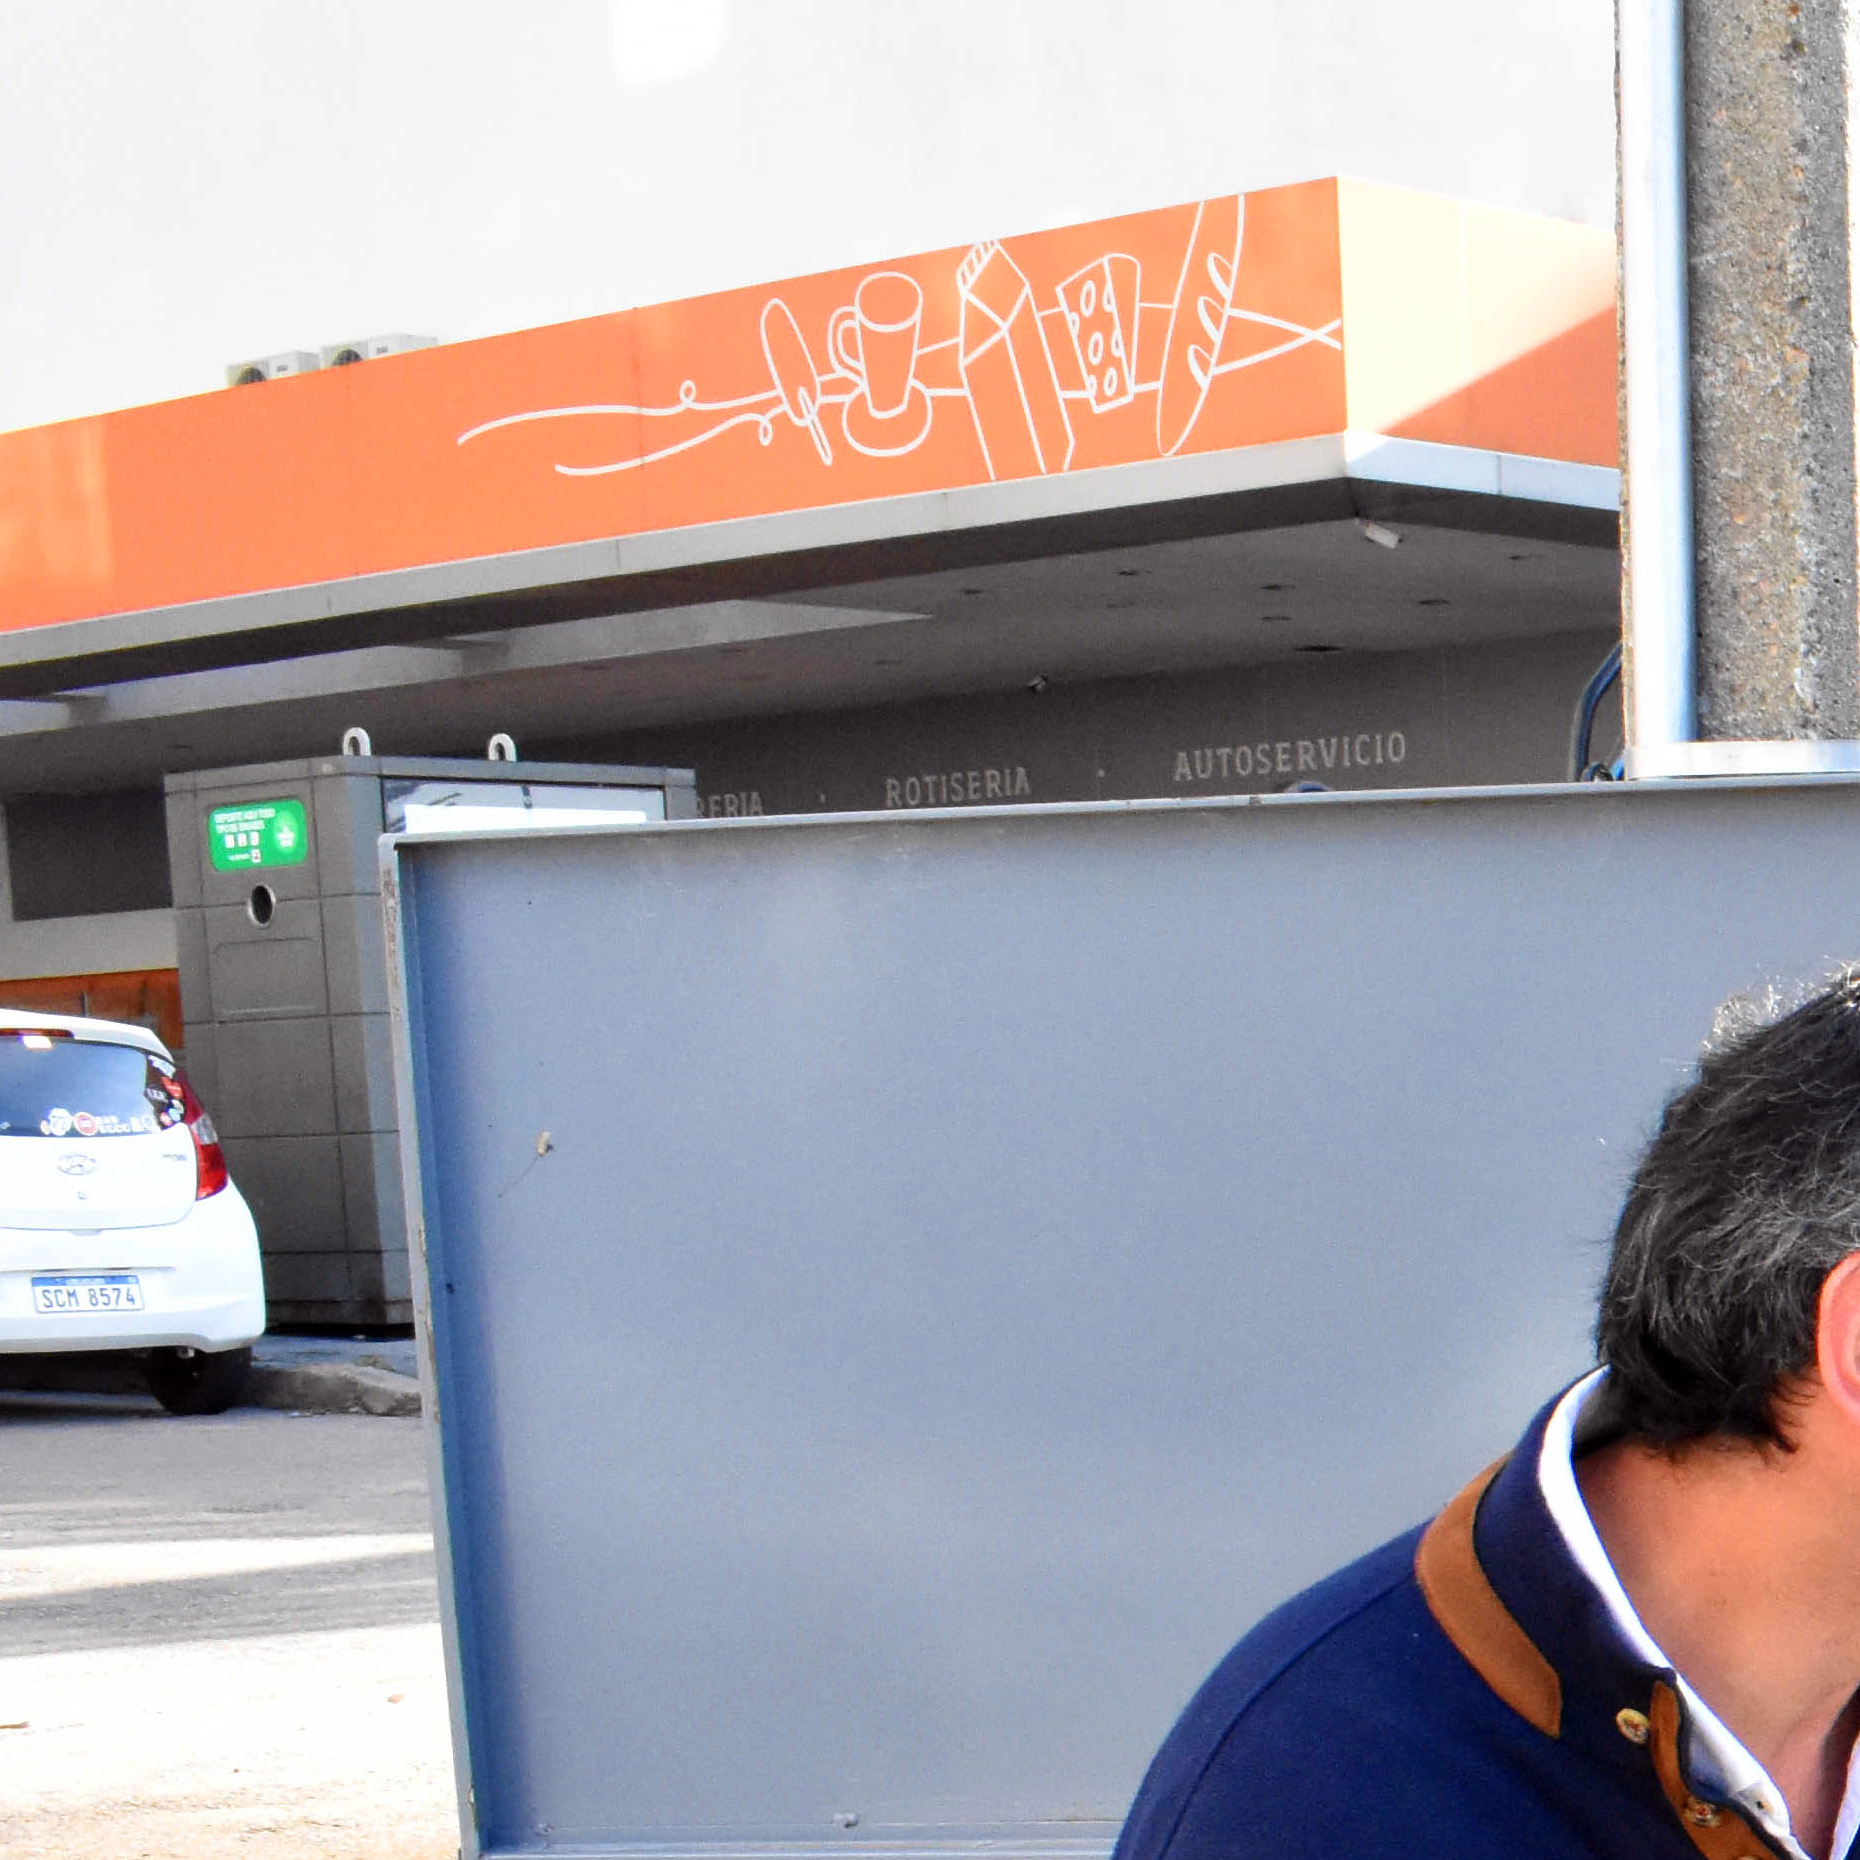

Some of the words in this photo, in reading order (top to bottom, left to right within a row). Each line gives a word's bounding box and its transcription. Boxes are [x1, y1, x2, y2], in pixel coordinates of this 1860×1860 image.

[1173, 730, 1407, 782] AUTOSERVICIO
[886, 765, 1031, 807] ROTISERIA
[41, 1287, 80, 1309] SCM
[87, 1286, 135, 1307] 8574
